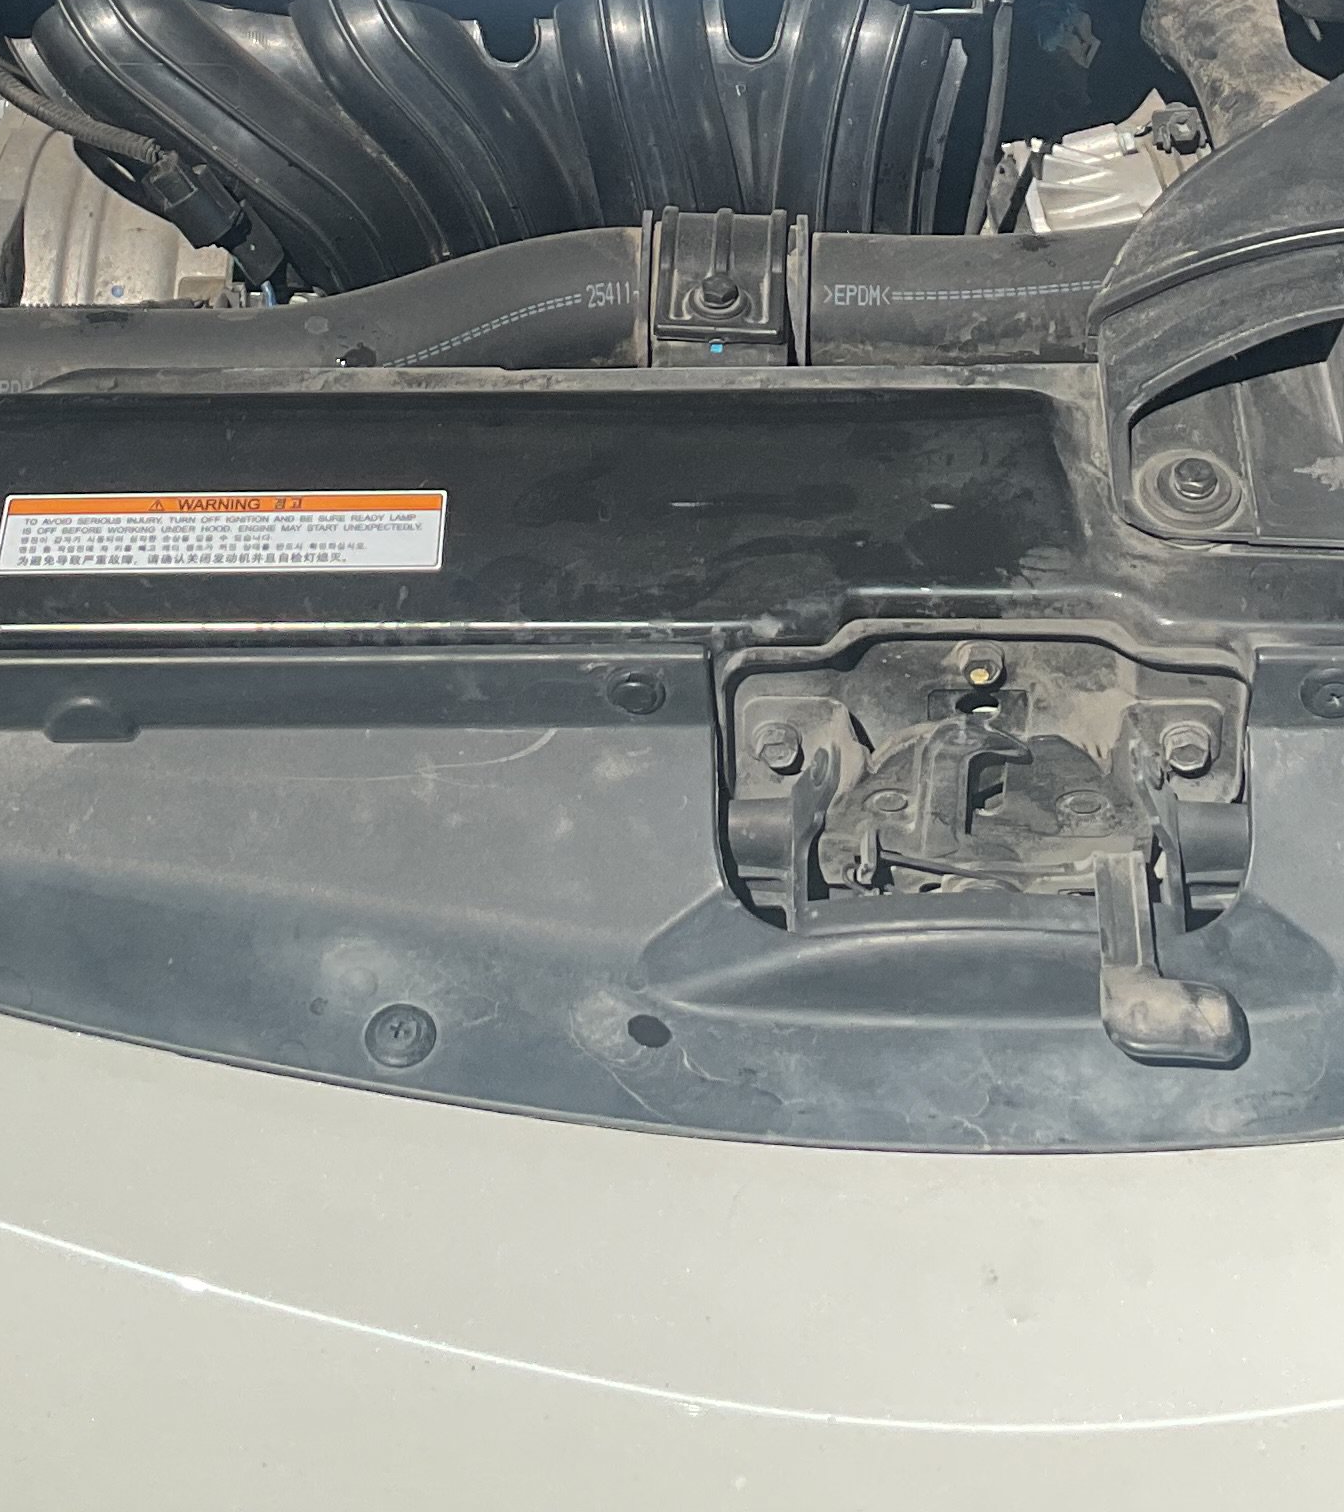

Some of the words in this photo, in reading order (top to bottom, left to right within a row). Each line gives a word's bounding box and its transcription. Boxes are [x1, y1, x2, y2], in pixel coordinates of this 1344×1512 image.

[823, 284, 890, 306] >EPDM<
[178, 498, 261, 511] WARNING
[25, 517, 38, 525] TO
[41, 517, 73, 525] AVOID
[77, 517, 122, 525] SERIOUS
[169, 516, 196, 524] TURN
[200, 515, 221, 524] OFF
[225, 515, 269, 523] IGNITION
[273, 514, 295, 523] AND
[300, 514, 314, 522] BE
[318, 514, 346, 522] SURE
[350, 514, 385, 522] READY
[389, 513, 417, 522] LAMP
[22, 527, 32, 535] IS
[37, 526, 57, 535] OFF
[61, 526, 102, 535] BEFORE
[107, 525, 156, 534] WORKING
[160, 525, 196, 533] UNDER
[238, 524, 276, 532] ENGINE
[280, 524, 302, 532] MAY
[307, 523, 338, 532] START
